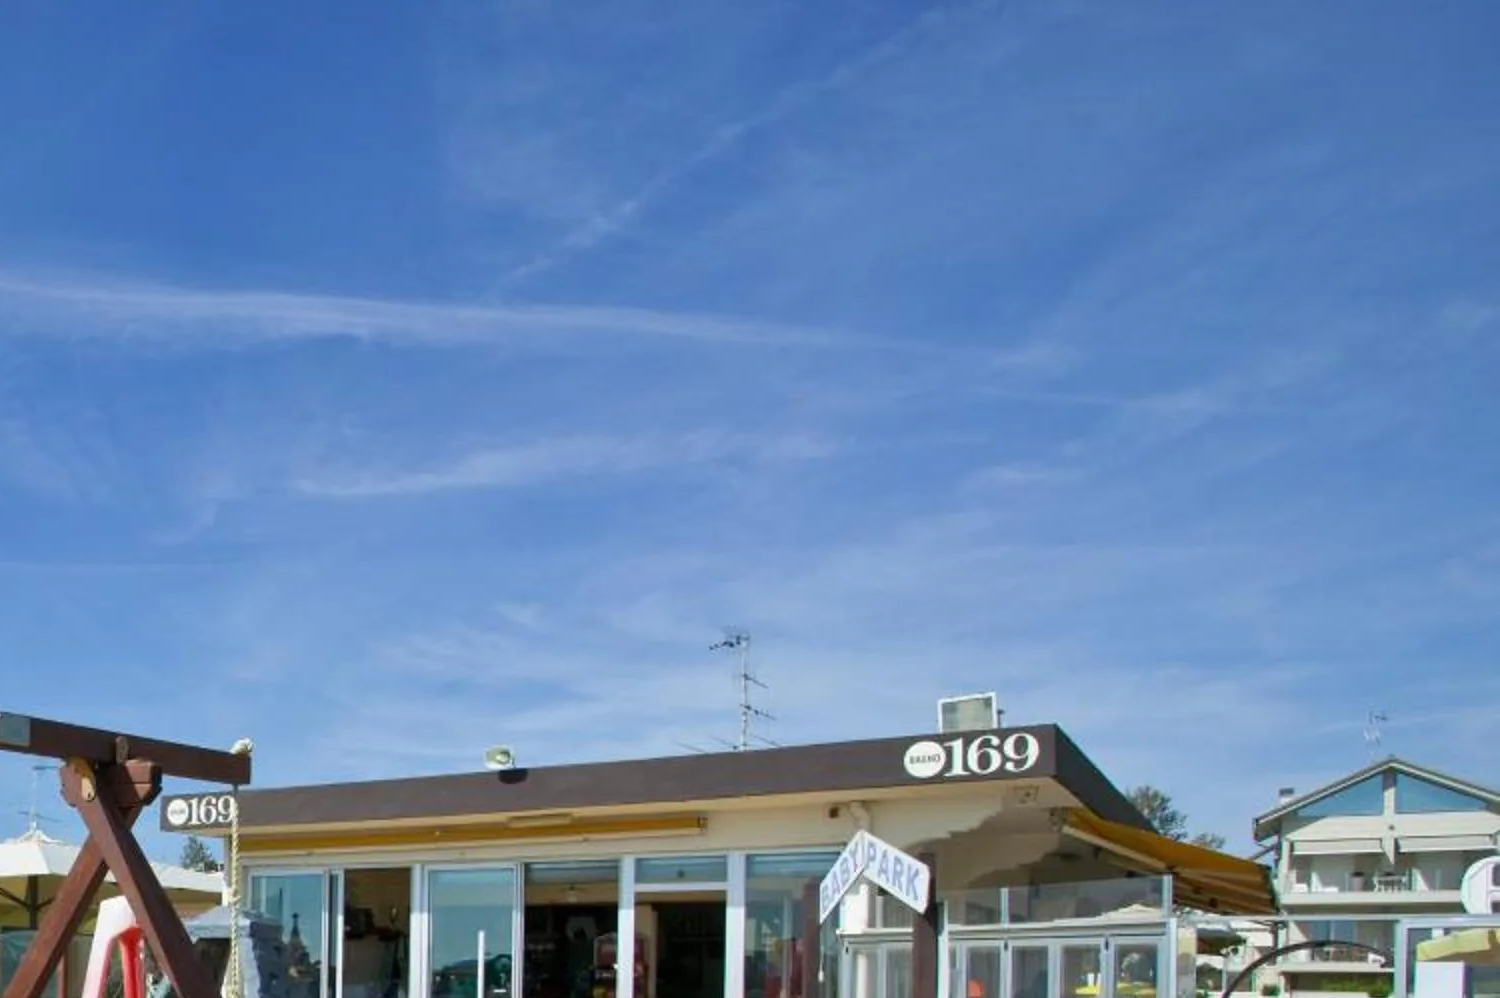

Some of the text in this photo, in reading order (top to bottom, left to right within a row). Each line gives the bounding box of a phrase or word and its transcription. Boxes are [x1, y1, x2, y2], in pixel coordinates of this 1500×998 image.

[944, 733, 1039, 777] 169
[188, 796, 236, 825] 169
[821, 840, 919, 912] BABY PARK
